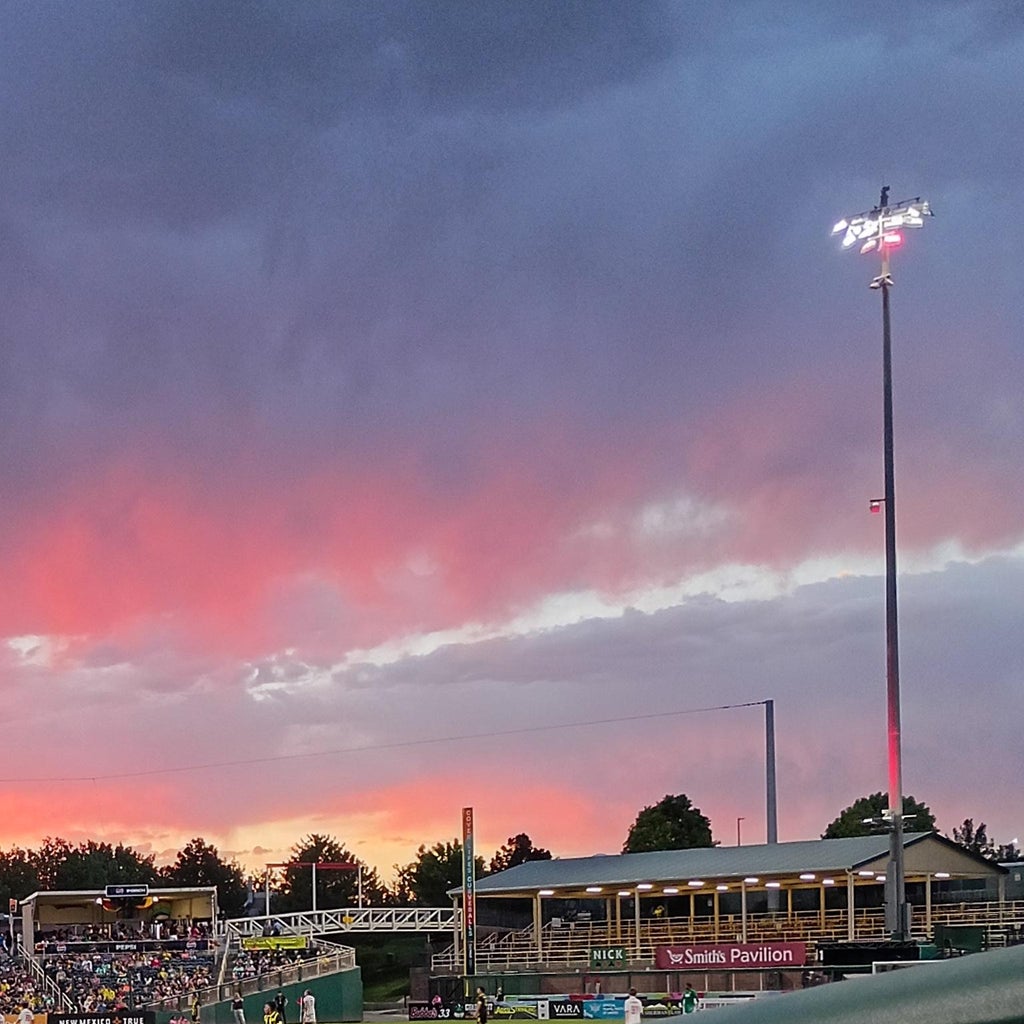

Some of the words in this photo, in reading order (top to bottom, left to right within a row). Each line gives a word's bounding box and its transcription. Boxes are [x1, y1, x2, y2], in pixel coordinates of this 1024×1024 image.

[593, 949, 624, 960] NICK
[684, 948, 726, 964] Smith's
[730, 946, 793, 963] Pavilion
[438, 1008, 451, 1018] 33
[553, 1004, 581, 1013] VARA
